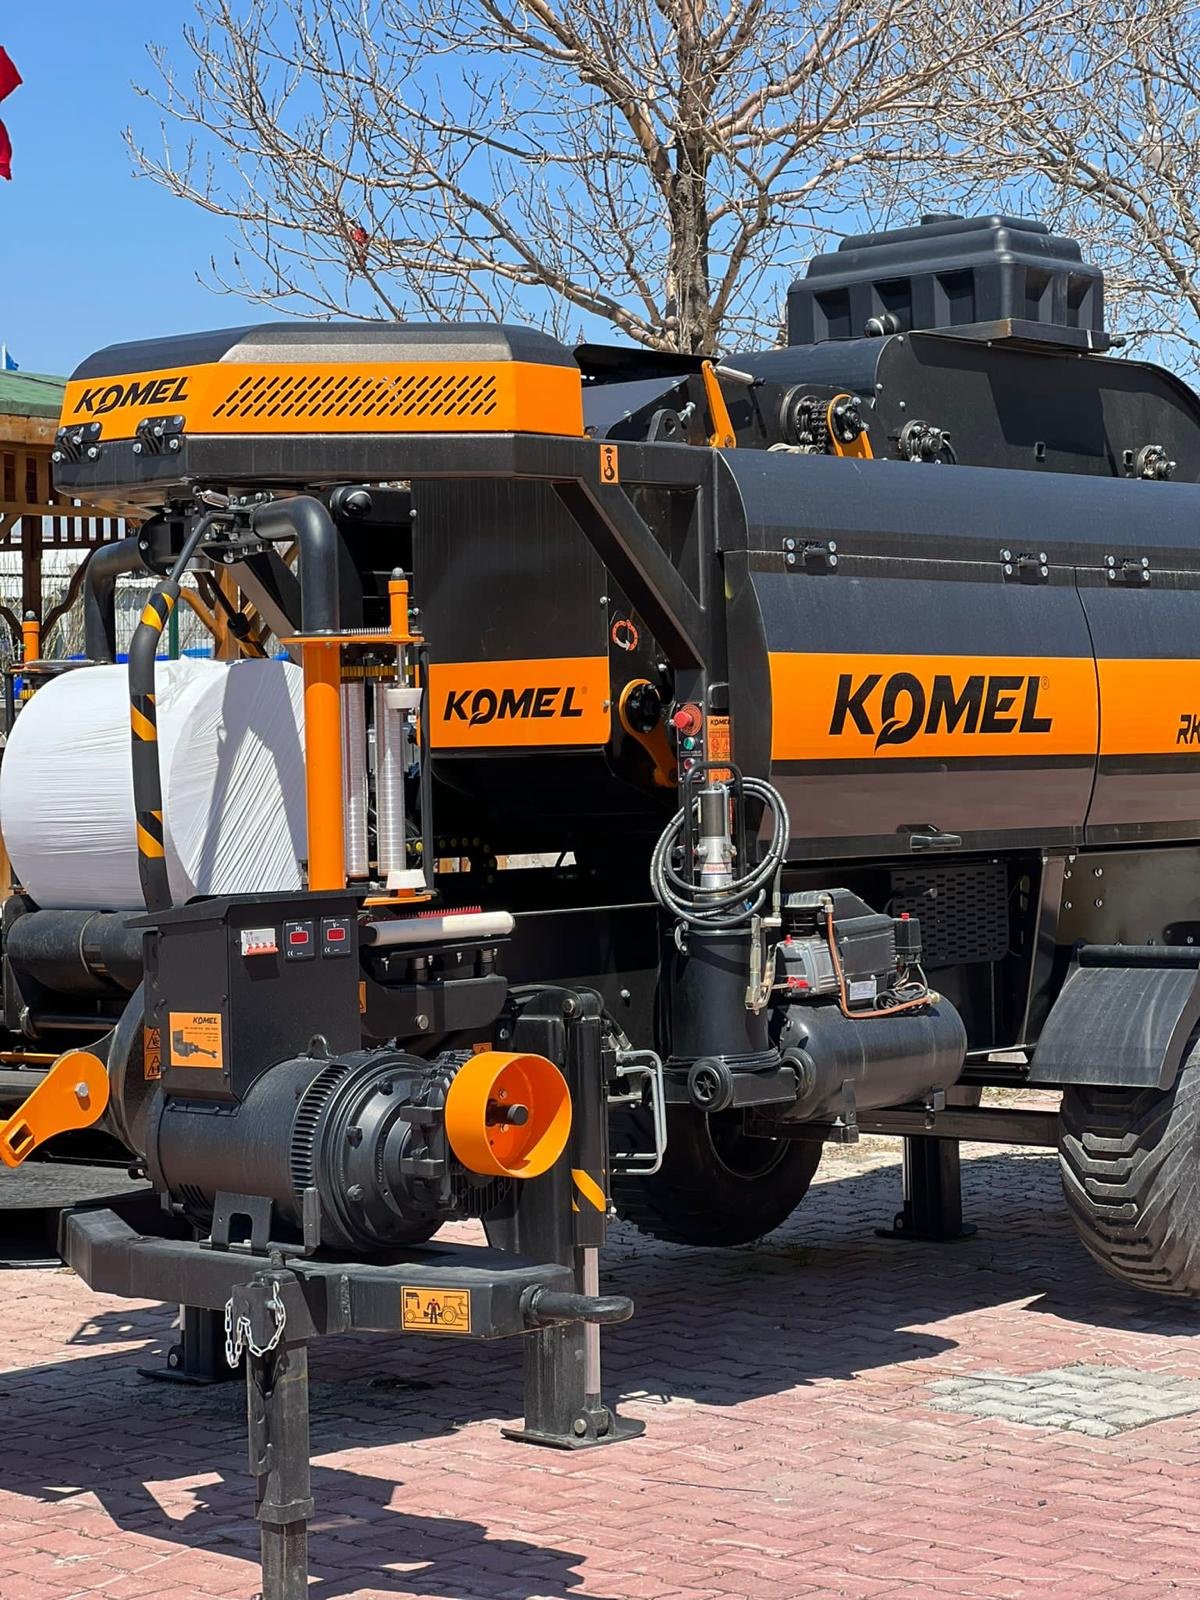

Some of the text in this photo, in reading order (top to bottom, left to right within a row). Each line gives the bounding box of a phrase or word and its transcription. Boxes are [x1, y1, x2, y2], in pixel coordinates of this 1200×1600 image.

[73, 377, 189, 416] KOMEL
[443, 687, 583, 728] KOMEL
[829, 672, 1053, 755] KOMEL
